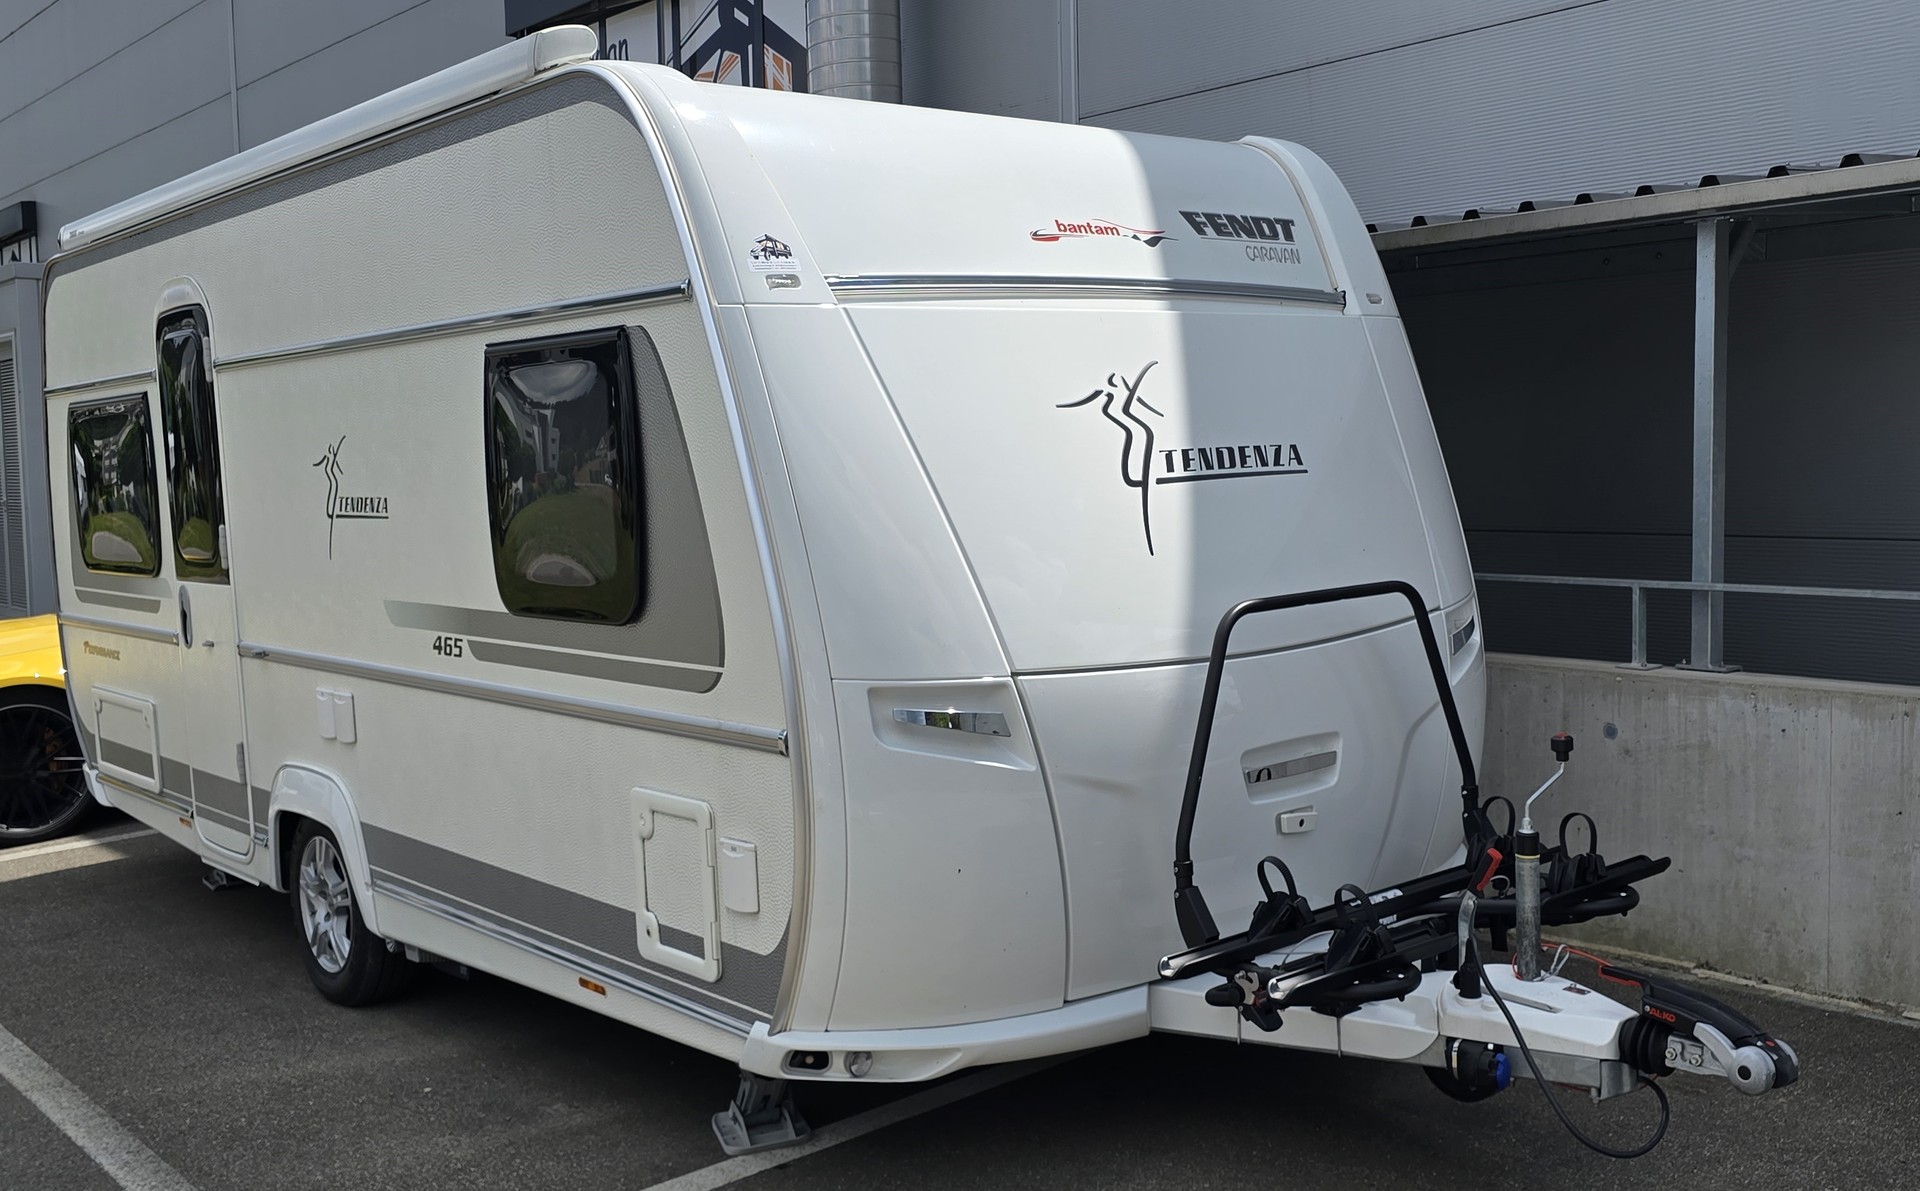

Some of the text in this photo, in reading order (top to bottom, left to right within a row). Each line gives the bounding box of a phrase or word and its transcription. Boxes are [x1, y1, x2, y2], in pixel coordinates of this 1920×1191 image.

[1055, 219, 1120, 236] bantam
[1179, 210, 1296, 242] FENDT
[1245, 245, 1301, 264] CARAVAN
[1159, 444, 1304, 473] TENDENZA
[338, 496, 388, 514] TENDENZA
[433, 635, 463, 658] 465
